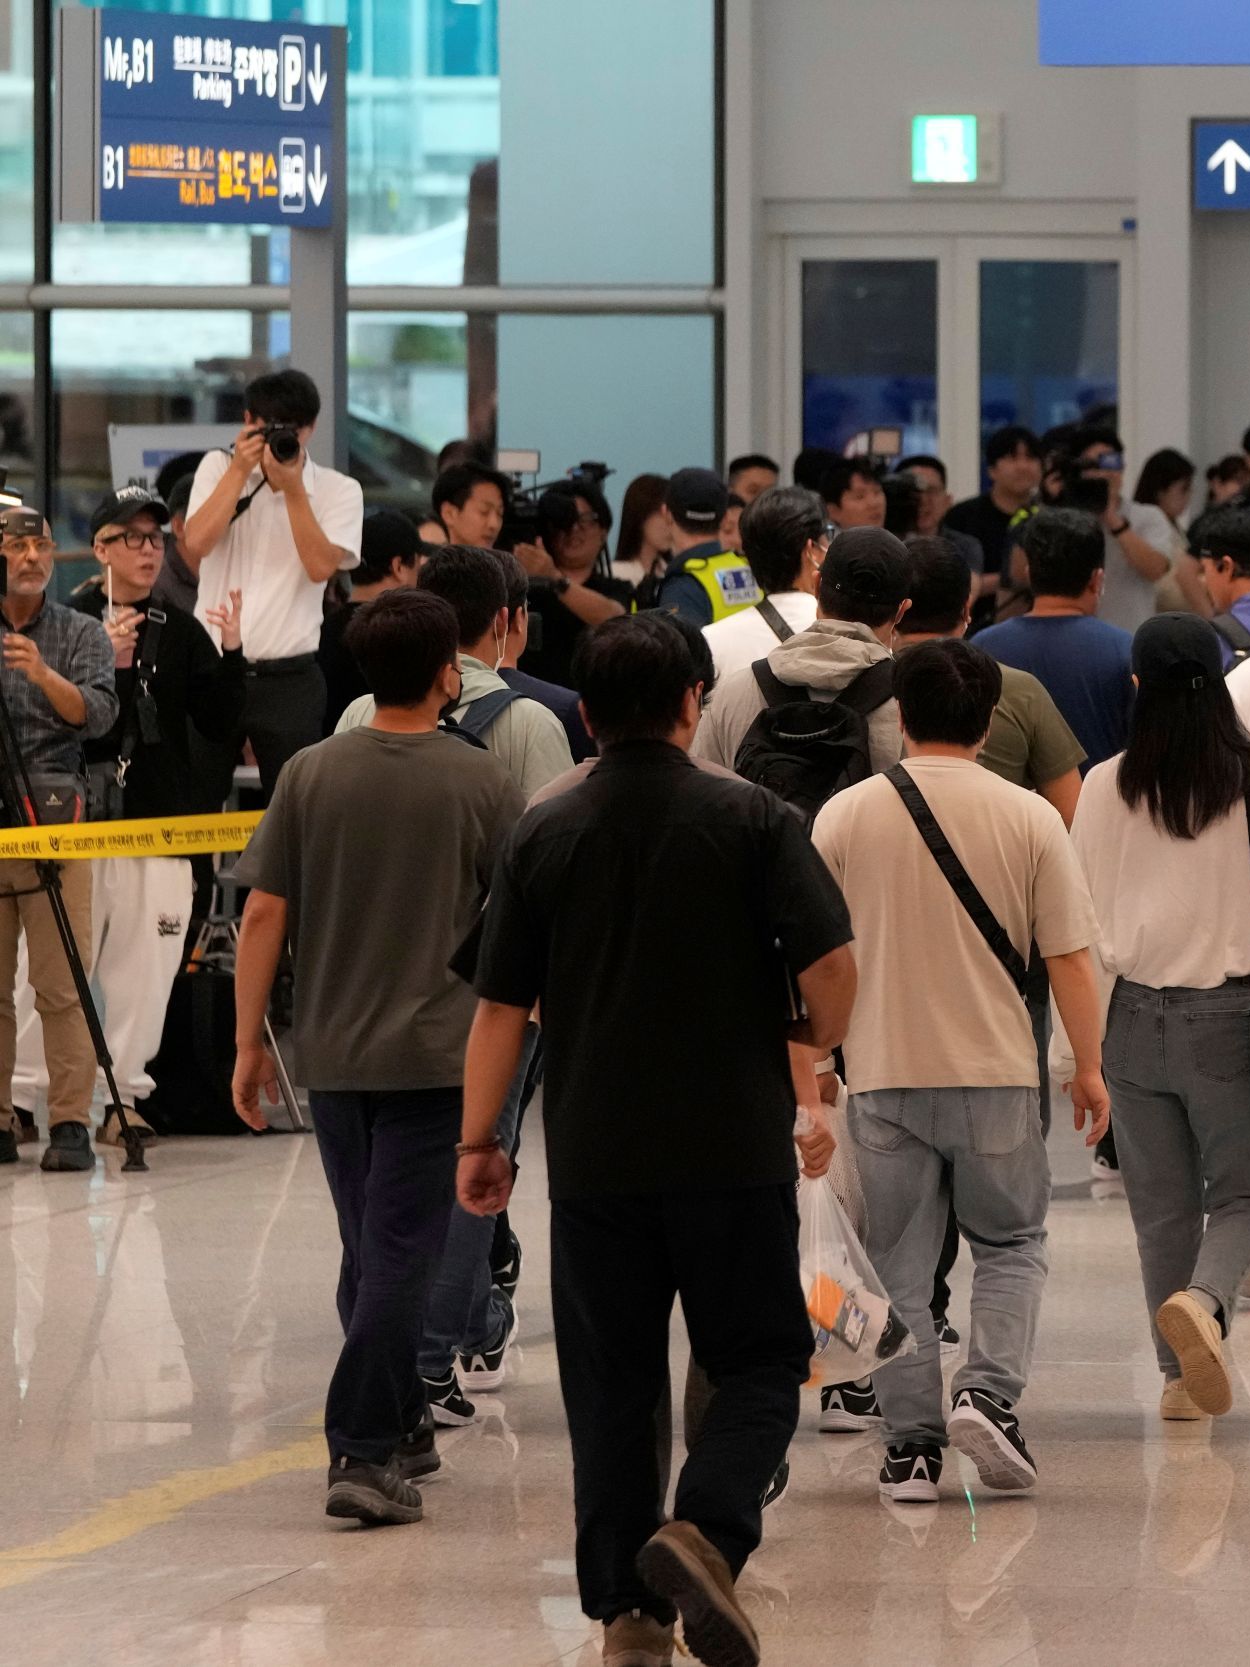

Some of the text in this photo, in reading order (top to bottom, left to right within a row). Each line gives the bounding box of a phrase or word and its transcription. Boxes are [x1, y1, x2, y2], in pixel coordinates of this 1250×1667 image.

[192, 72, 232, 108] Parking
[233, 46, 279, 98] 주차장
[103, 144, 124, 190] B1
